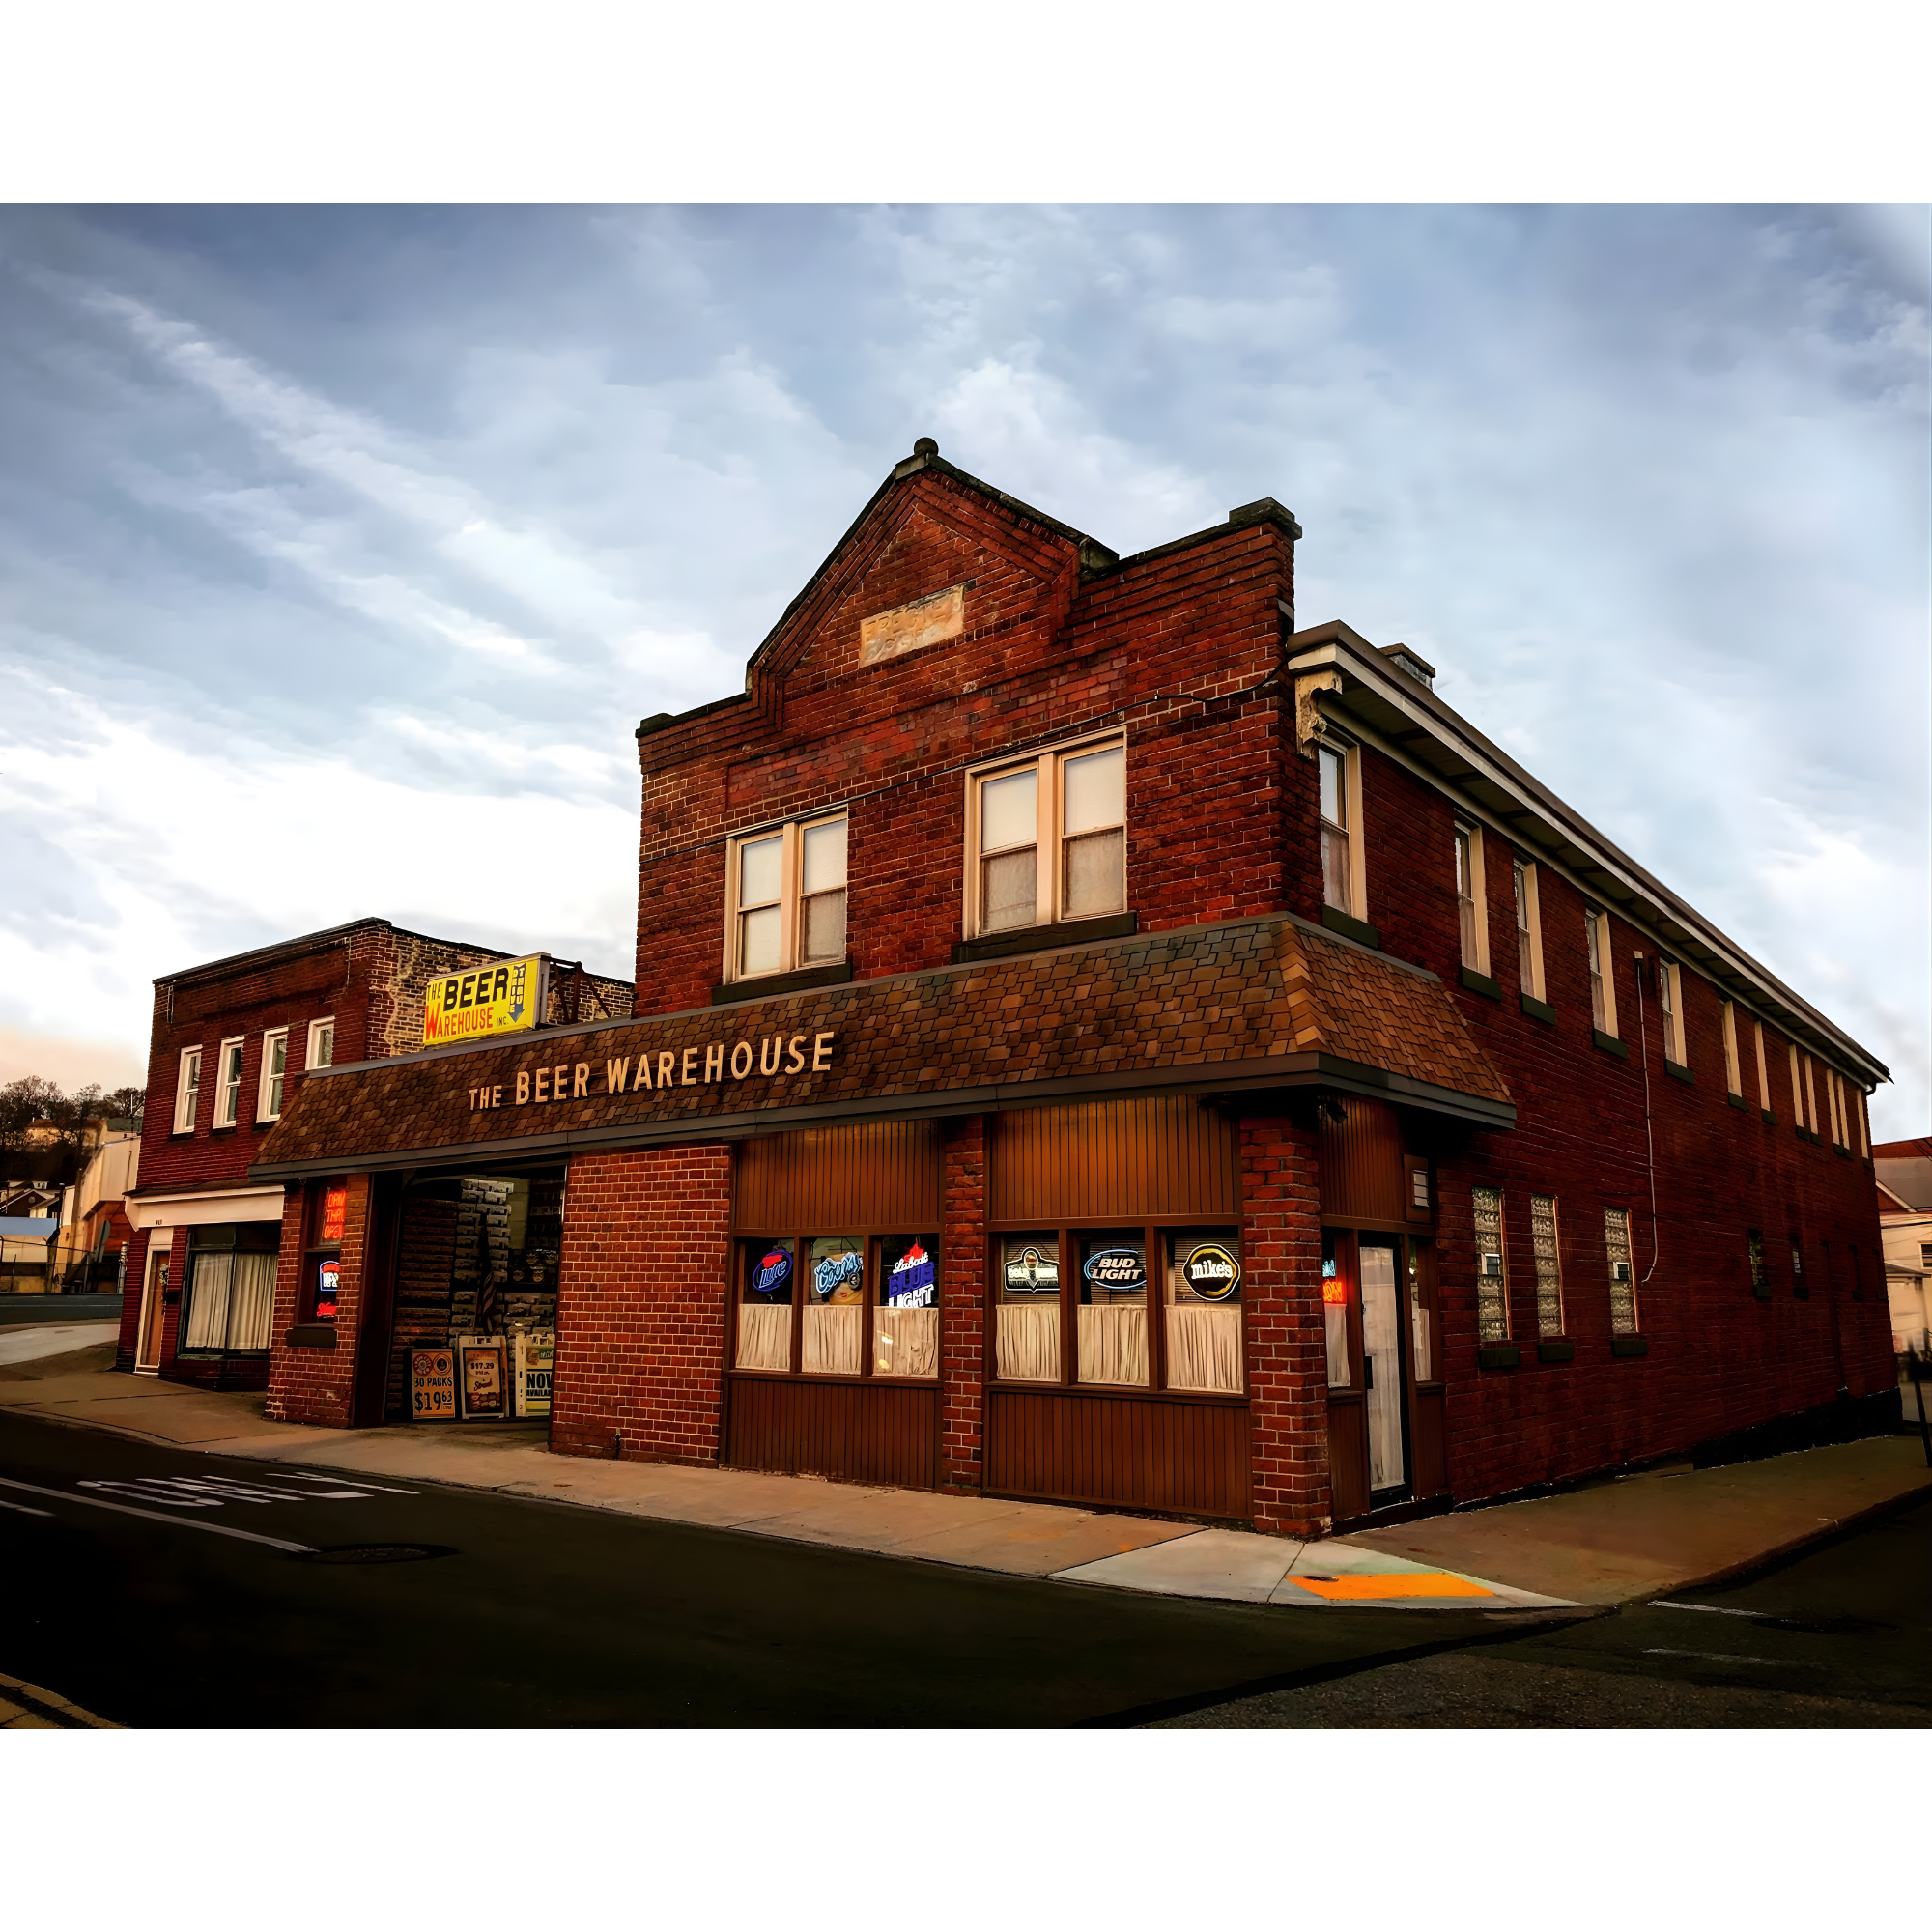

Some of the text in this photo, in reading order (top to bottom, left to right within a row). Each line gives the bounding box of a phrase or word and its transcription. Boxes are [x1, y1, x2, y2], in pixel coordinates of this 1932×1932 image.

[426, 968, 509, 1012] THE BEER
[425, 1002, 494, 1040] WAREHOUSE
[469, 1031, 835, 1111] THE BEER WAREHOUSE
[892, 1252, 929, 1274] Labatt
[1091, 1268, 1143, 1280] LIGHT
[1098, 1258, 1136, 1268] BUD
[1190, 1260, 1234, 1280] mike's
[889, 1262, 934, 1297] BLUE
[888, 1284, 934, 1308] LIGHT
[414, 1376, 453, 1387] 30 PACKS
